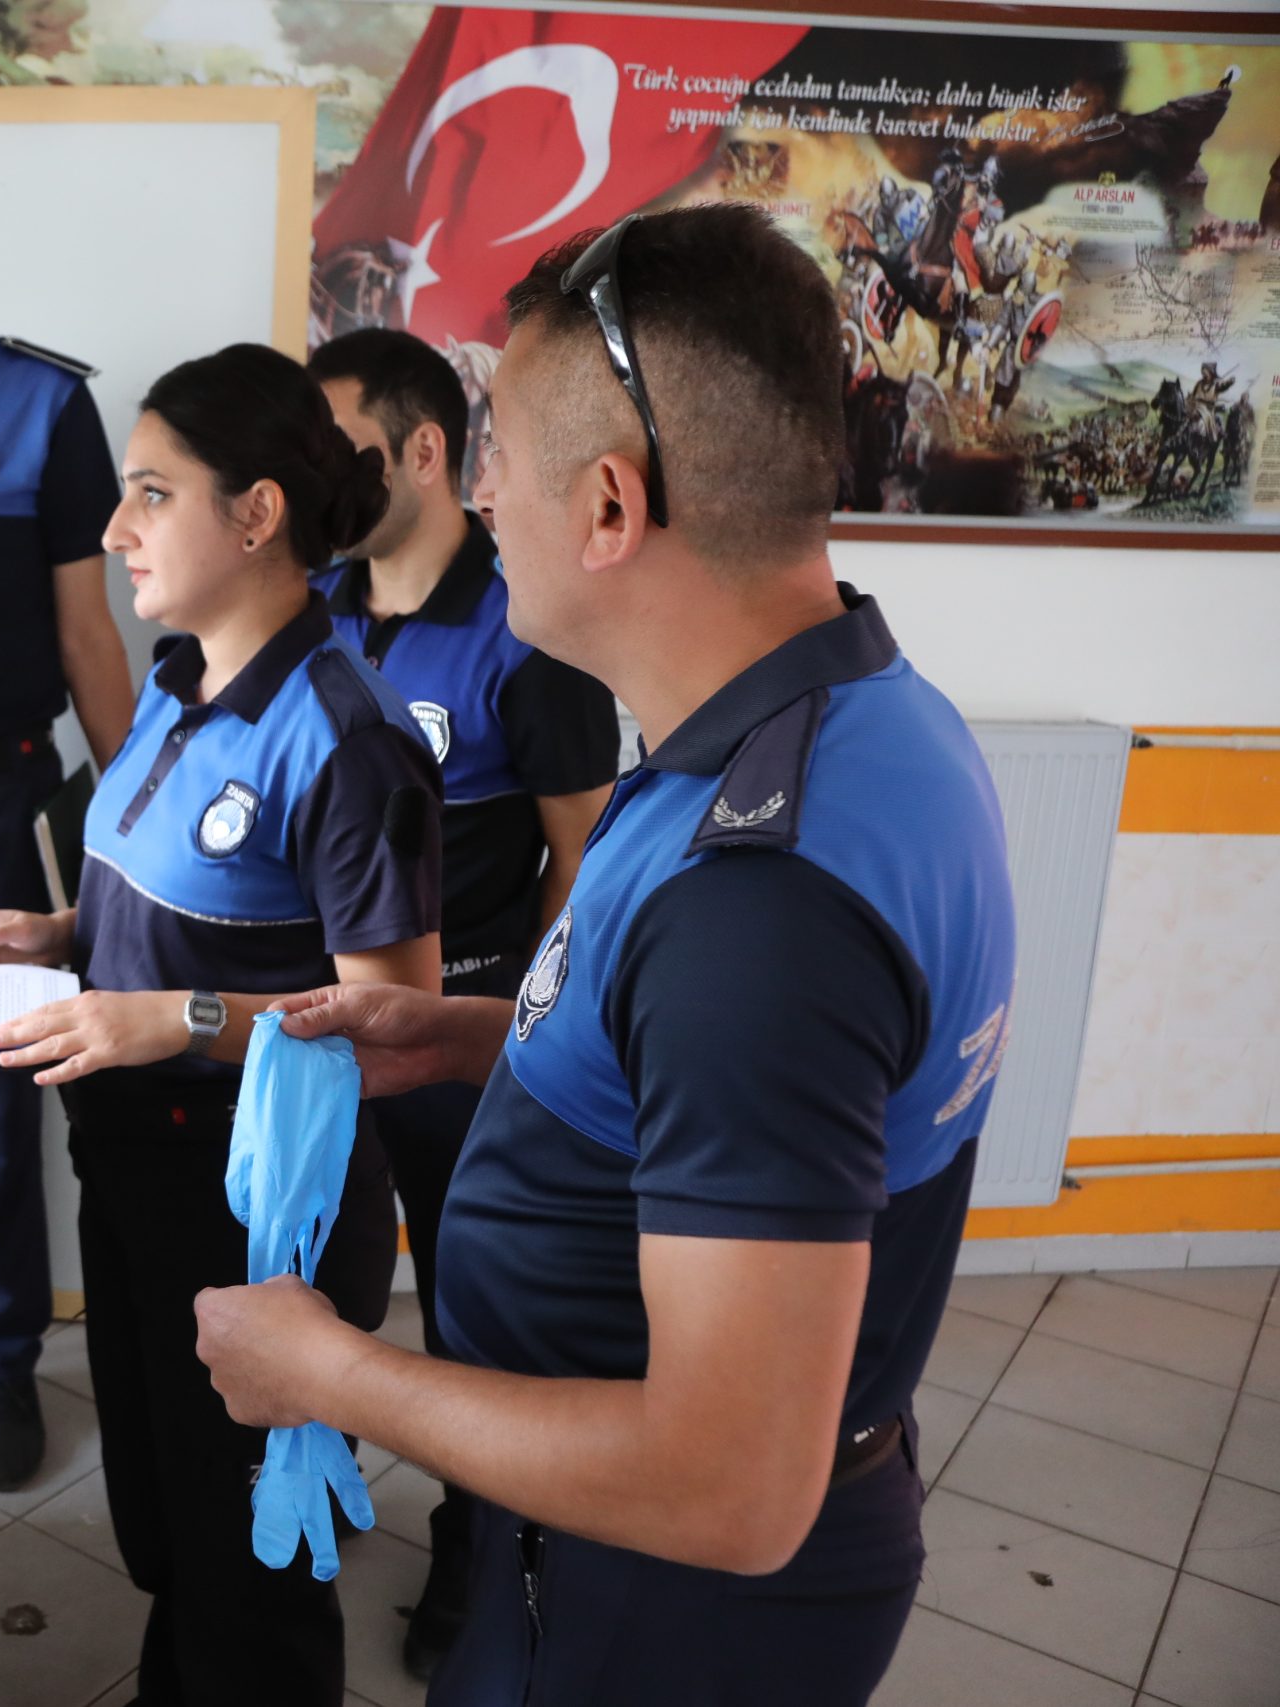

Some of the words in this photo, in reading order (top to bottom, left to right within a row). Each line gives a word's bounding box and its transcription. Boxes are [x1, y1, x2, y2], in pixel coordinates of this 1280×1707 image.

[623, 62, 678, 91] Türk
[683, 73, 751, 103] çocuğu
[936, 81, 983, 108] daha
[987, 83, 1043, 114] büyük
[1046, 87, 1088, 113] işler
[666, 102, 746, 134] yapmak
[750, 105, 783, 130] için
[787, 105, 871, 135] kendinde
[875, 109, 940, 137] kuvvet
[943, 114, 1040, 143] bulacaktır.
